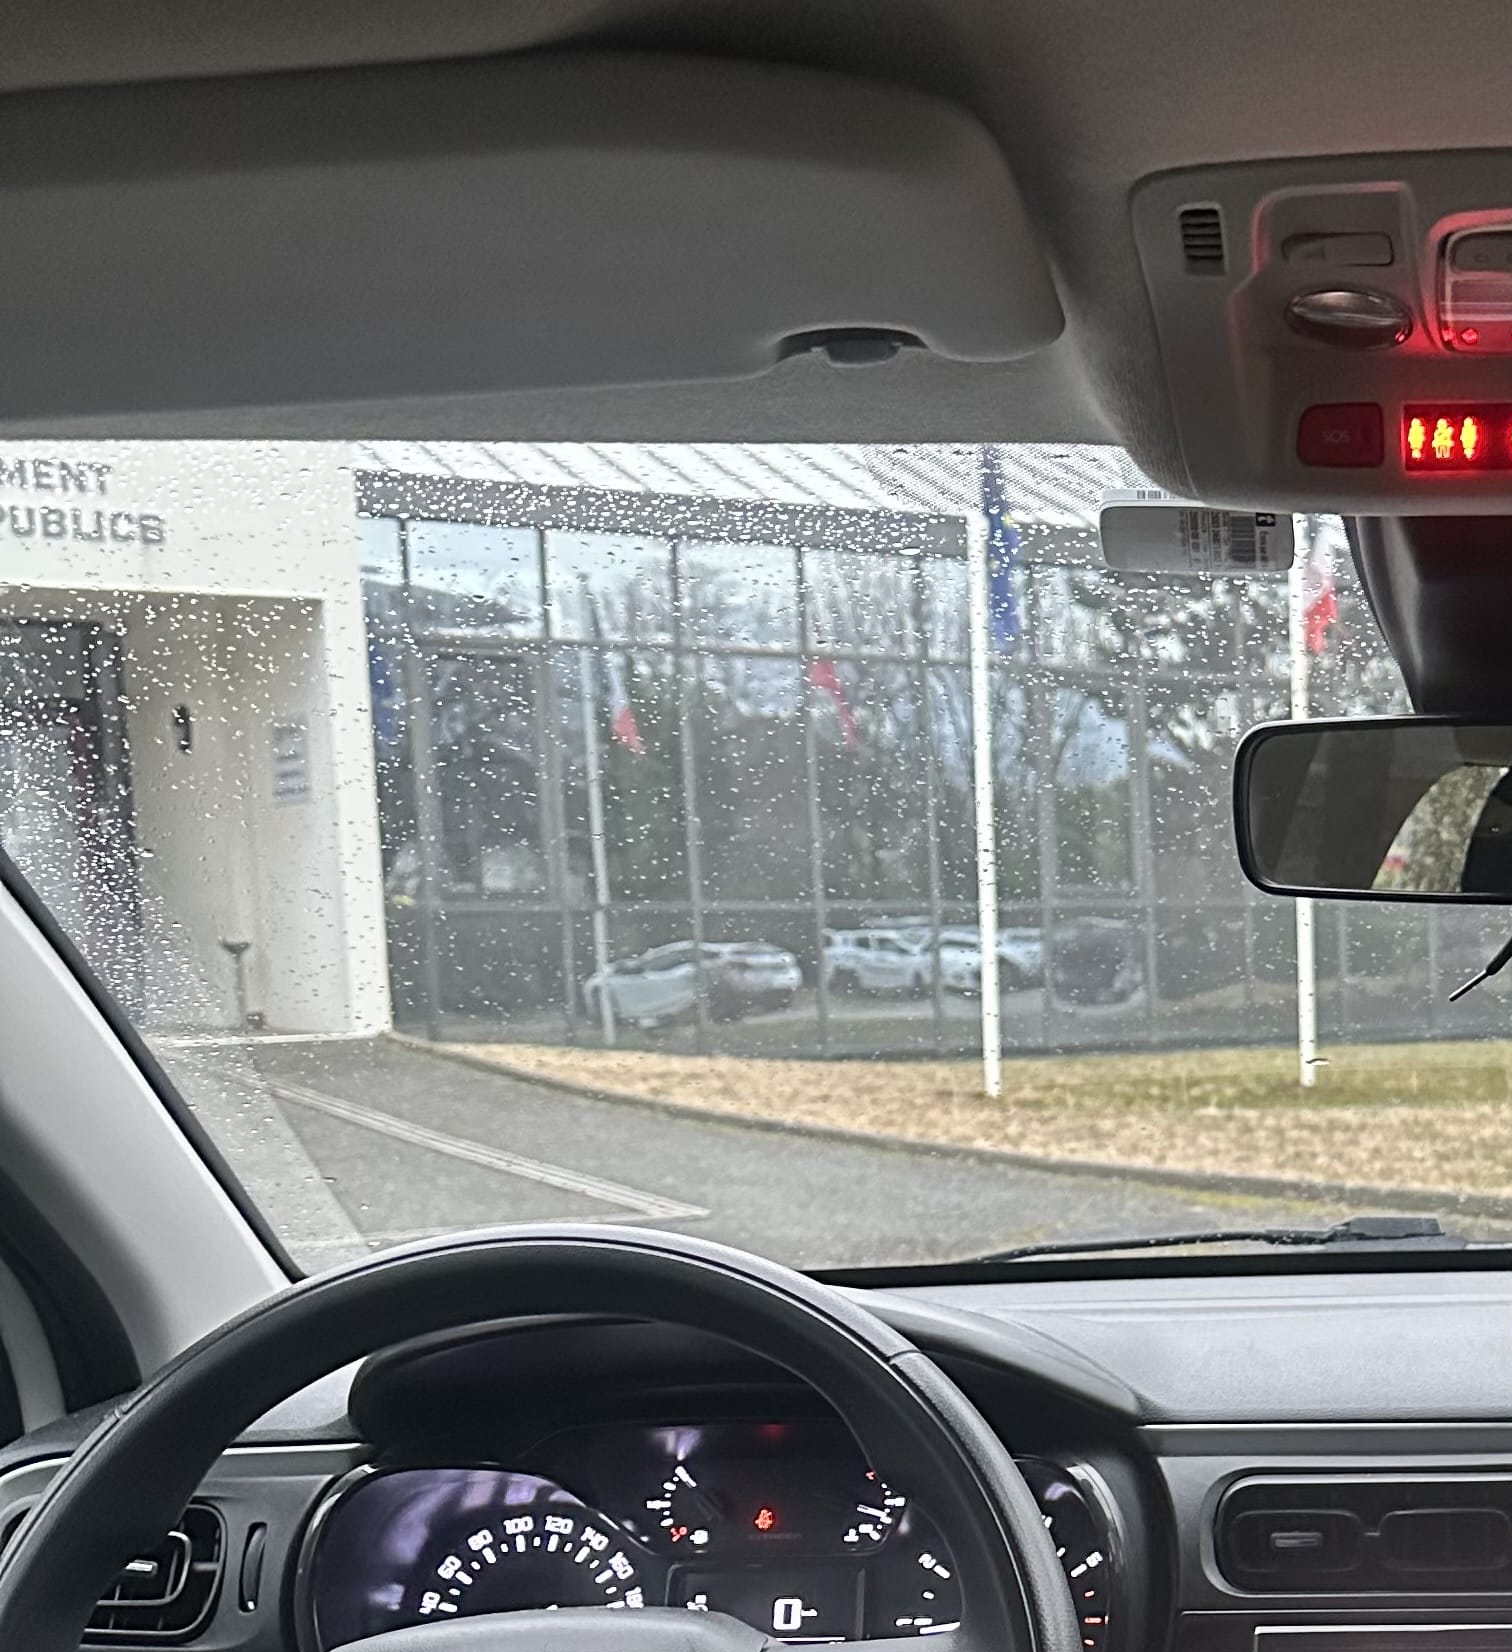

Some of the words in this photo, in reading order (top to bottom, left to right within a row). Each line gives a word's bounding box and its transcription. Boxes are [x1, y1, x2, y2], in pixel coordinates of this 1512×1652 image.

[1321, 429, 1352, 443] SOS
[503, 1516, 534, 1535] 100
[544, 1516, 574, 1535] 120
[467, 1529, 494, 1551] 80
[580, 1526, 609, 1551] 140
[437, 1555, 462, 1580] 60
[608, 1551, 634, 1580] 160
[418, 1591, 441, 1615] 40
[773, 1598, 802, 1631] 0
